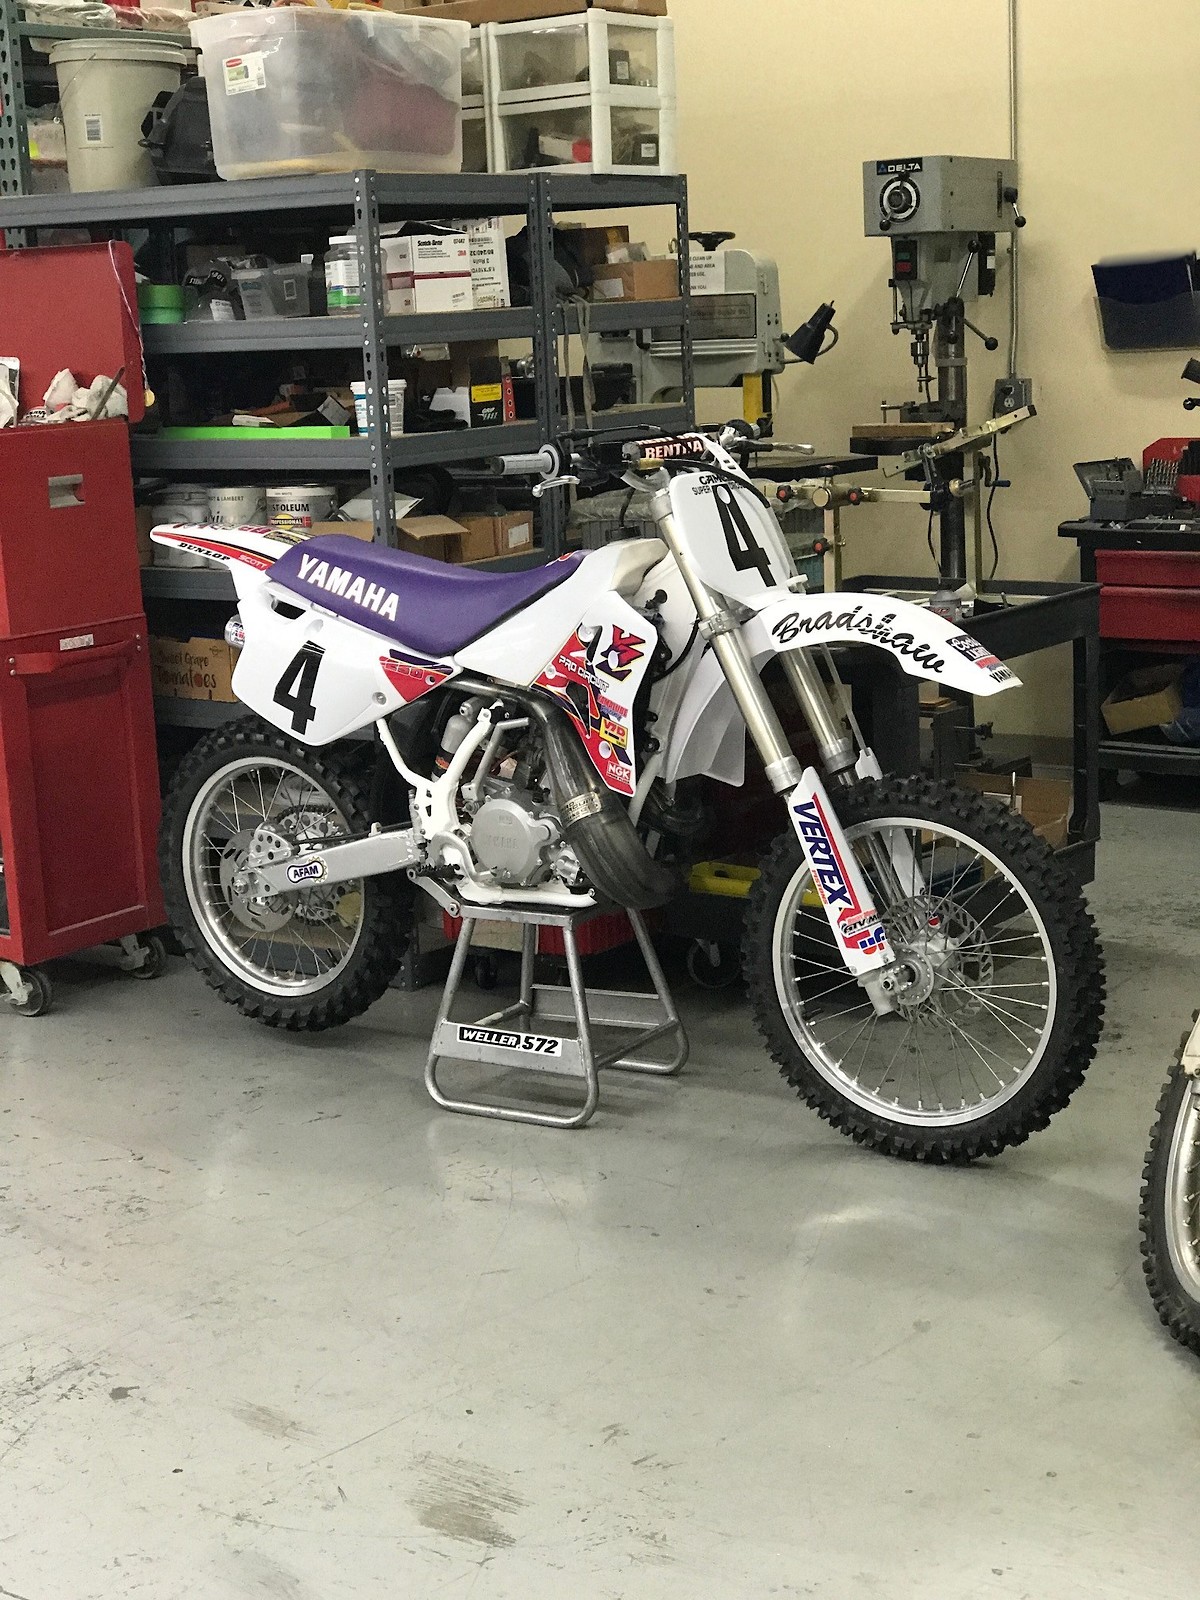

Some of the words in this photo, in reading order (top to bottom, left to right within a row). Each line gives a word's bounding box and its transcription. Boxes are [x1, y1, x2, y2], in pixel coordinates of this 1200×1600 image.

[887, 163, 921, 173] DELTA
[177, 542, 231, 562] DUNLOP
[711, 484, 777, 587] 4
[238, 554, 268, 569] SCOTT
[297, 553, 400, 622] YAMAHA
[771, 605, 946, 673] Bradshaw
[273, 640, 327, 735] 4
[558, 655, 577, 672] PRO
[577, 667, 610, 693] CIRCUIT
[607, 763, 632, 781] NGK
[293, 865, 320, 879] AFAM
[793, 801, 853, 907] VERTEX
[811, 868, 829, 905] PISTONS
